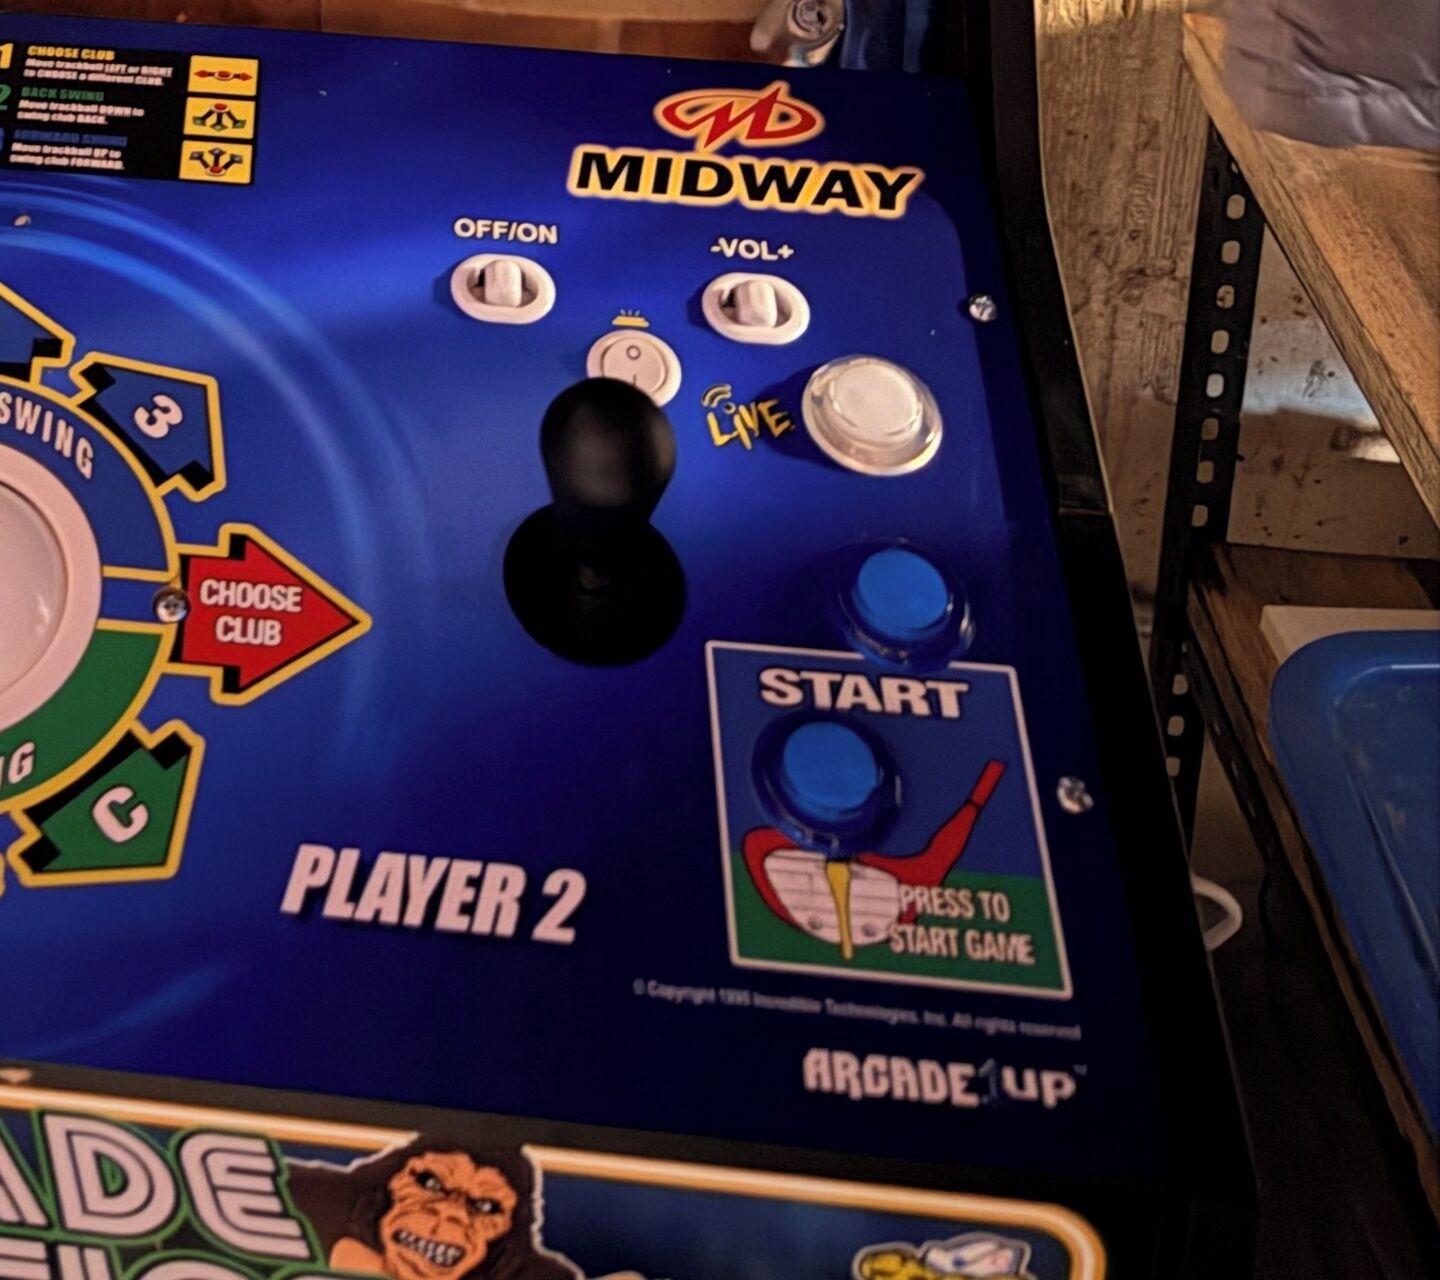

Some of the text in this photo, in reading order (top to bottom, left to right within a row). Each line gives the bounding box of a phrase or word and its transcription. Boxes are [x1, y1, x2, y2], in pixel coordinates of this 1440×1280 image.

[27, 45, 116, 61] CHOOSE CLUB
[21, 86, 59, 98] BACK
[572, 148, 920, 214] MIDWAY
[451, 217, 559, 244] OFF/ON
[132, 393, 184, 439] 3
[199, 578, 303, 614] CHOOSE
[214, 614, 283, 647] CLUB
[758, 667, 970, 719] START
[91, 784, 151, 843] C
[279, 842, 588, 946] PLAYER 2
[898, 883, 1012, 923] PRESS TO
[888, 924, 1037, 966] START GAME
